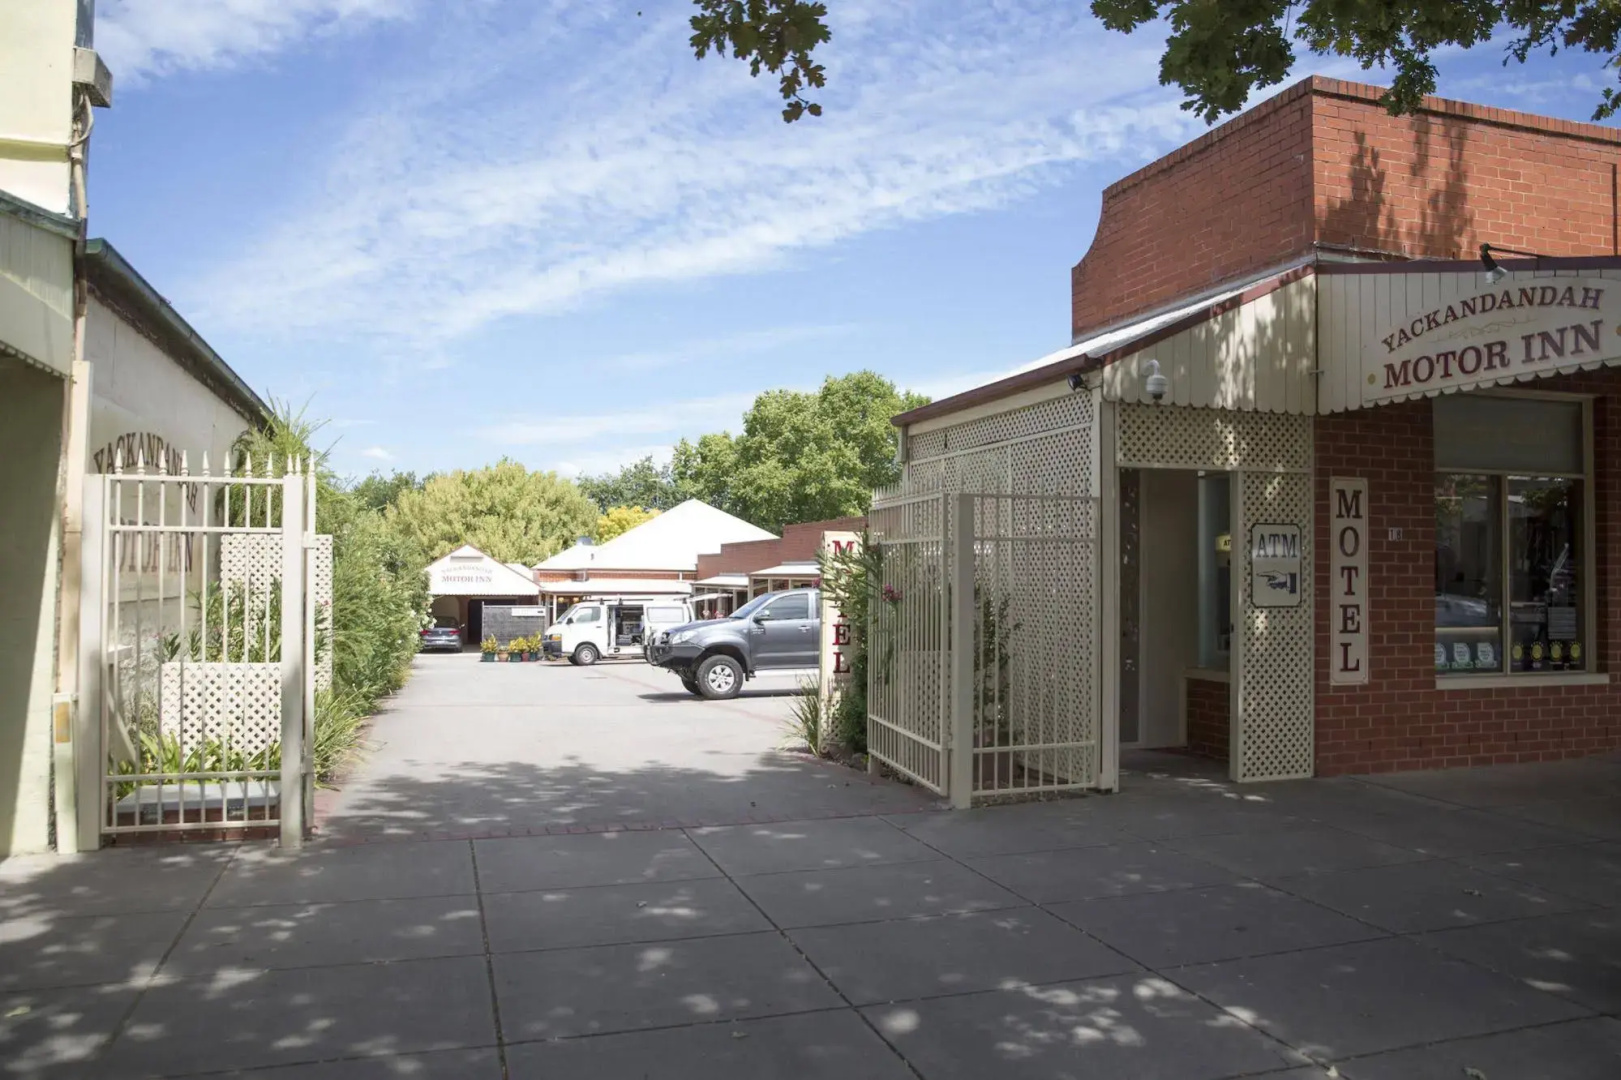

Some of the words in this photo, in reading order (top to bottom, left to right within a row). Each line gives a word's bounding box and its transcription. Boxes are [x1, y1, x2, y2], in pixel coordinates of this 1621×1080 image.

[1381, 285, 1605, 353] YACKANDANDAH
[1383, 340, 1511, 389] MOTOR
[1521, 319, 1604, 364] INN
[1223, 539, 1232, 547] AT
[1255, 533, 1298, 559] ATM
[441, 575, 474, 583] MOTOR
[475, 575, 492, 583] INN
[832, 540, 855, 674] MEL
[1335, 488, 1363, 672] MOTEL
